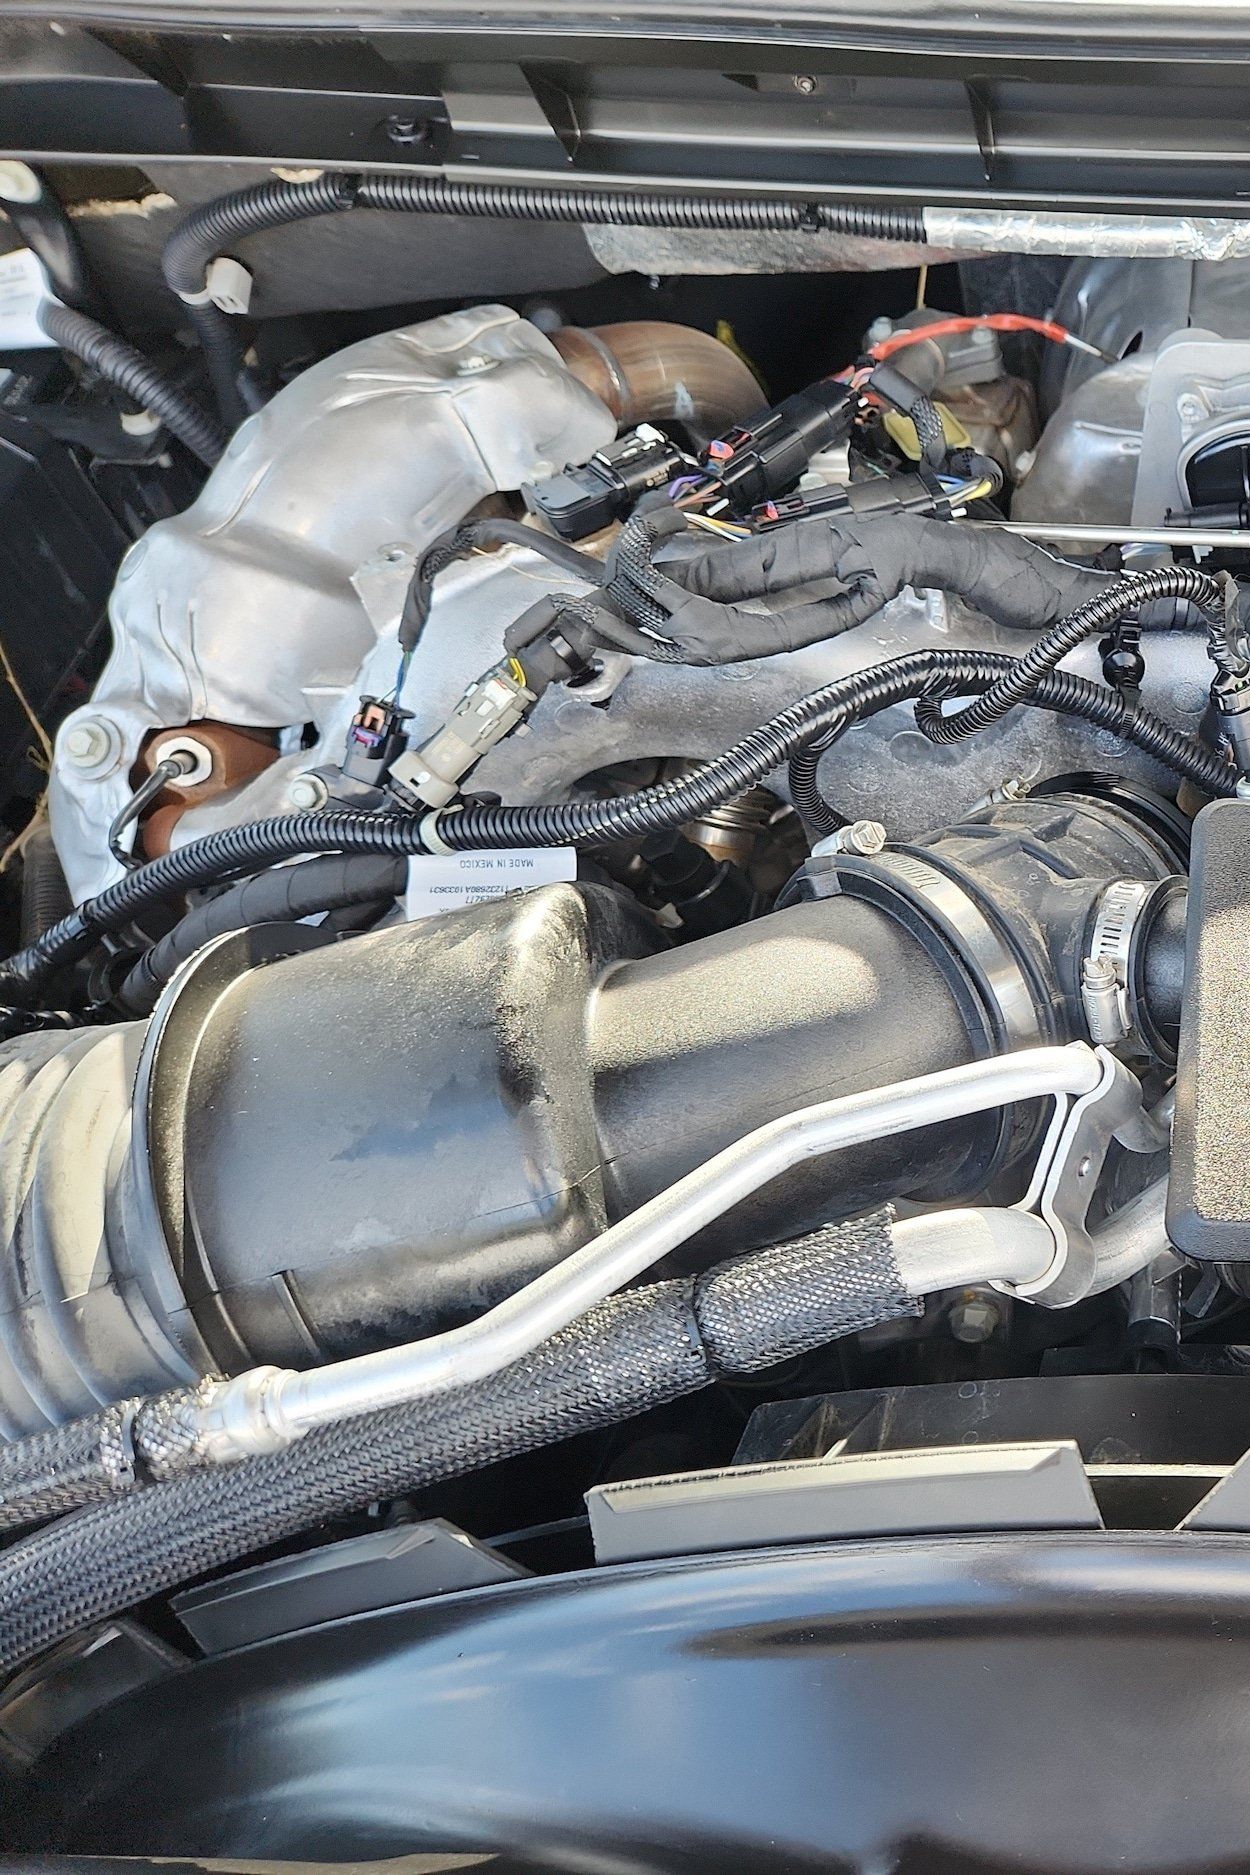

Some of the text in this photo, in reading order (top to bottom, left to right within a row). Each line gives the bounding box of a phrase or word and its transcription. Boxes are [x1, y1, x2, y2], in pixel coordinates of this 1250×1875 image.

[459, 859, 534, 869] MADE IN MEXICO
